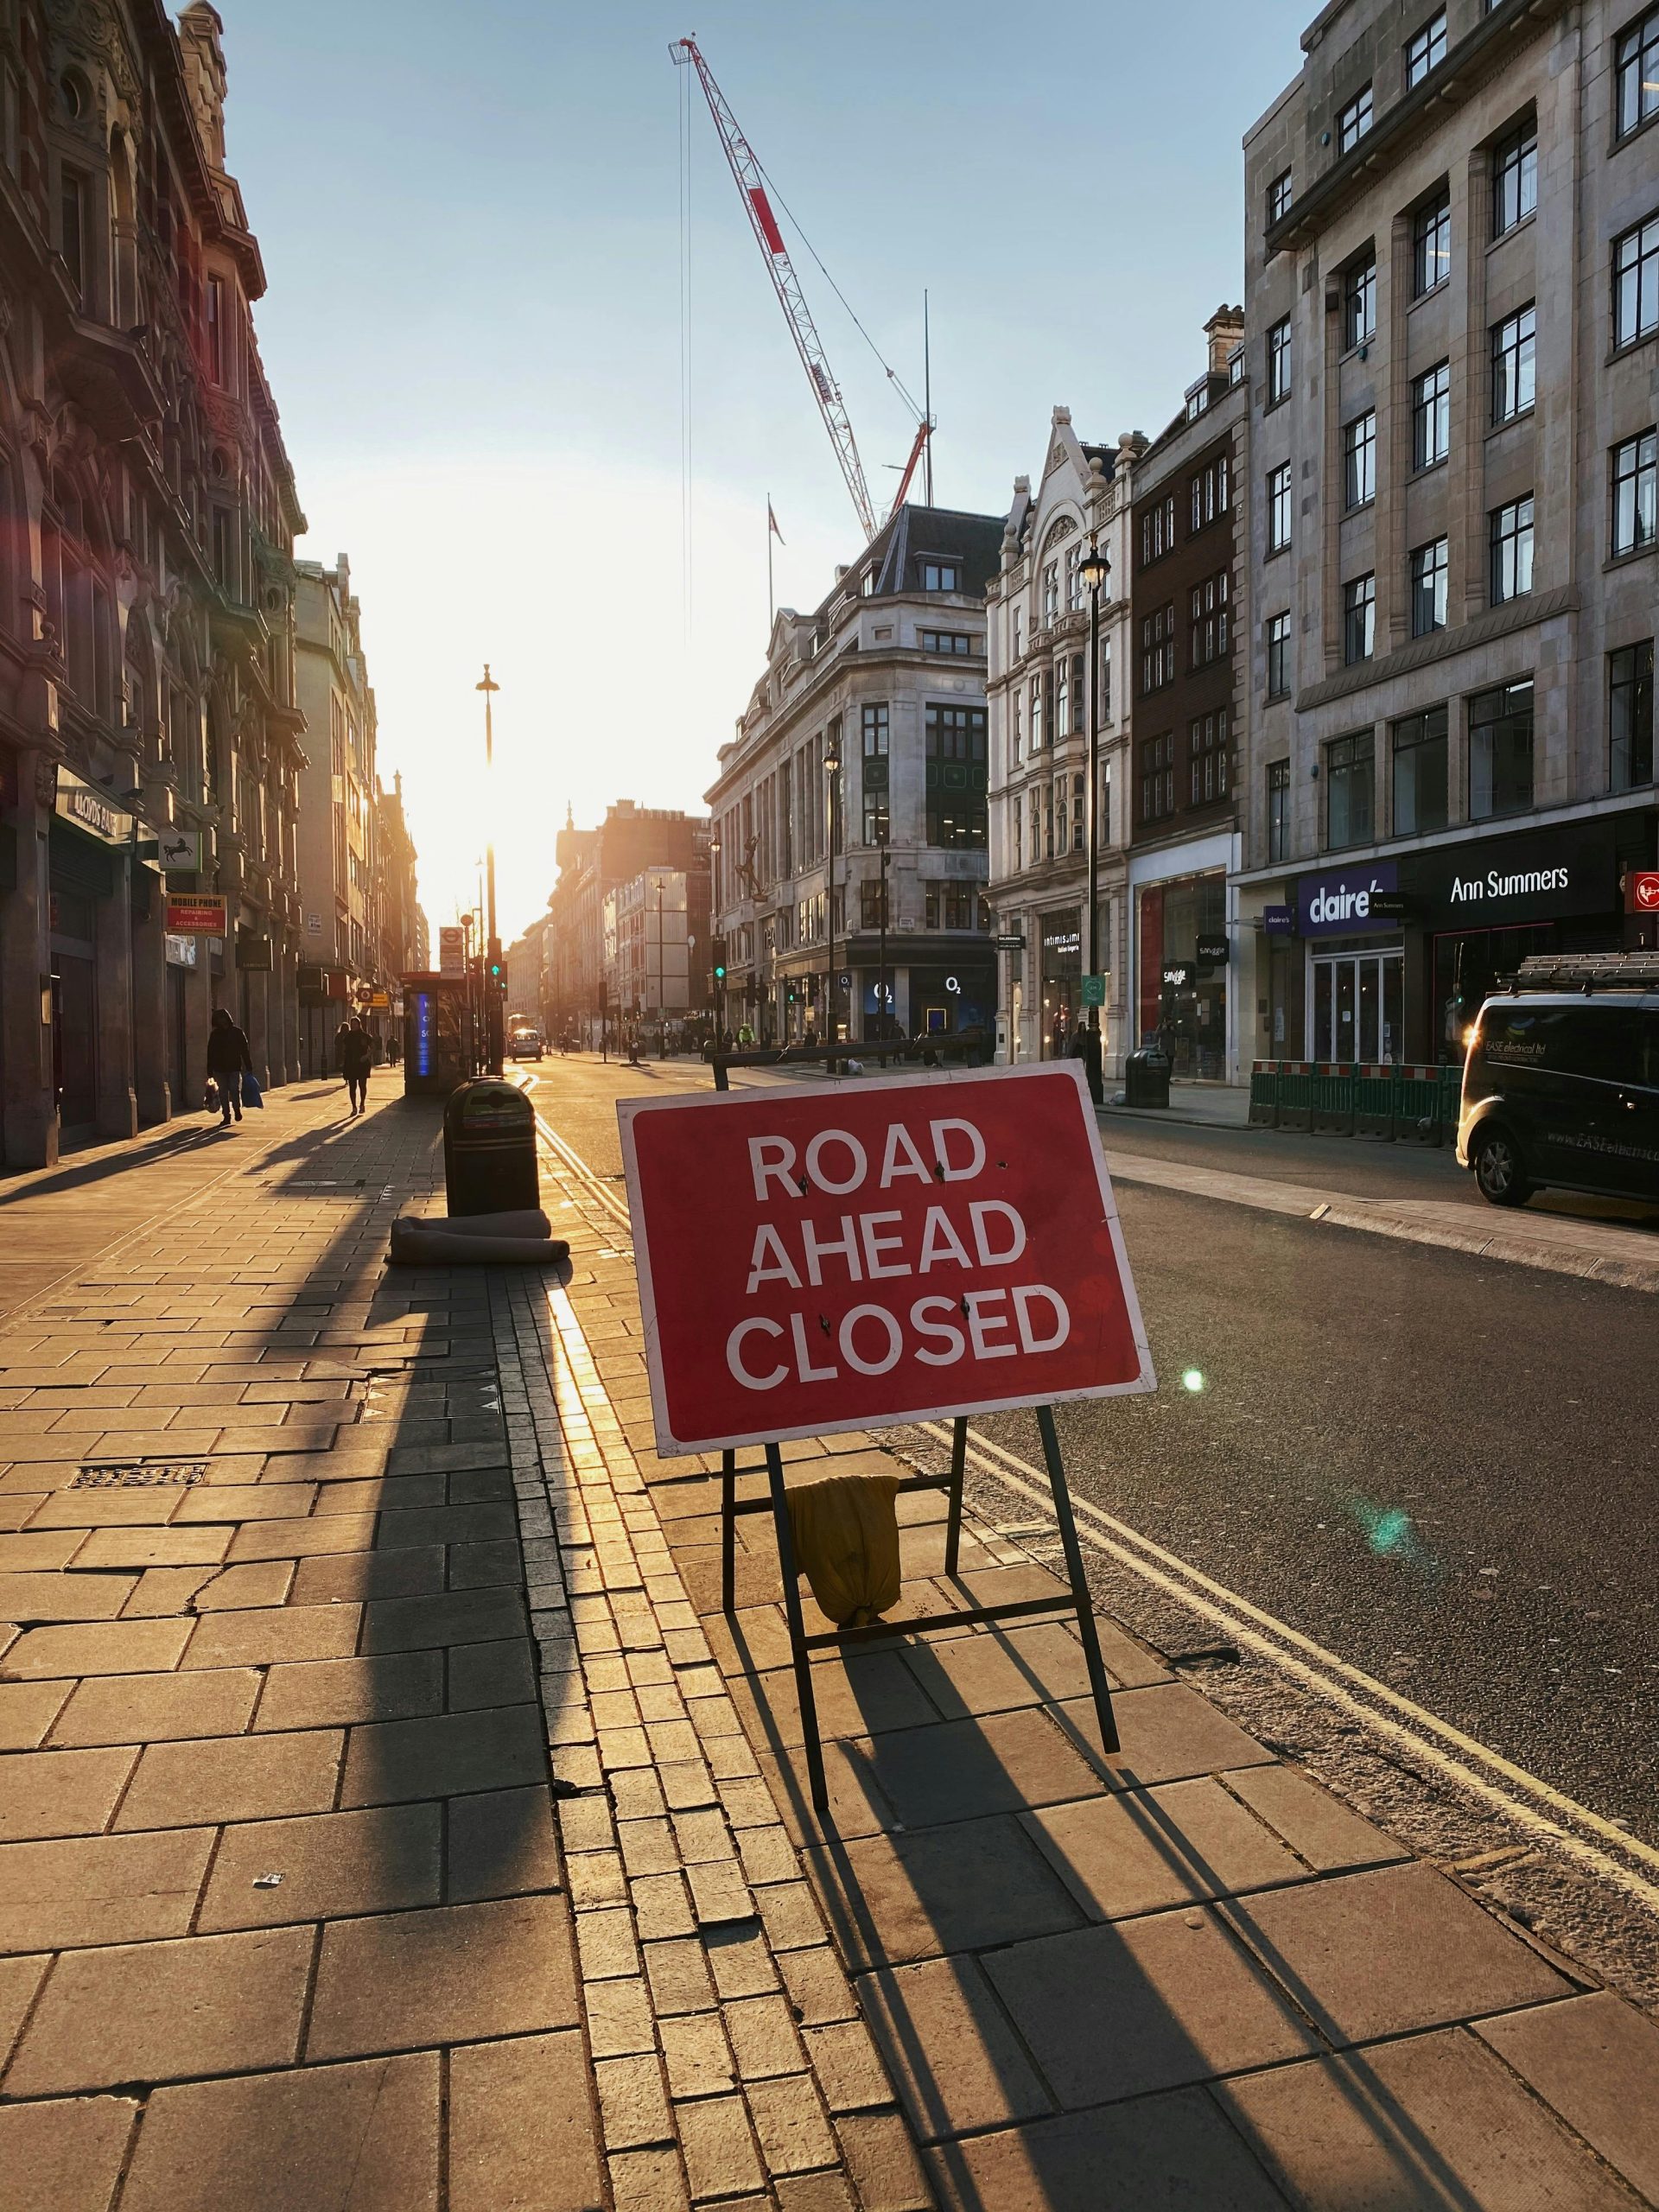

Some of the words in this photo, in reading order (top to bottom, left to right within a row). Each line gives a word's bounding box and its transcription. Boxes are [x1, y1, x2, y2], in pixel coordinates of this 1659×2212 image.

[74, 790, 100, 826] LLOYDS
[171, 898, 197, 907] MOBILE
[199, 899, 222, 908] PHONE
[1309, 879, 1384, 924] claire'
[1450, 876, 1484, 903] Ann
[1487, 868, 1568, 898] Summers
[1199, 947, 1225, 956] smiggle
[1485, 1040, 1503, 1052] EASE
[1503, 1040, 1535, 1054] electrical
[1535, 1043, 1546, 1055] ltd
[747, 1118, 986, 1202] ROAD
[745, 1200, 1027, 1294] AHEAD
[726, 1284, 1071, 1391] CLOSED
